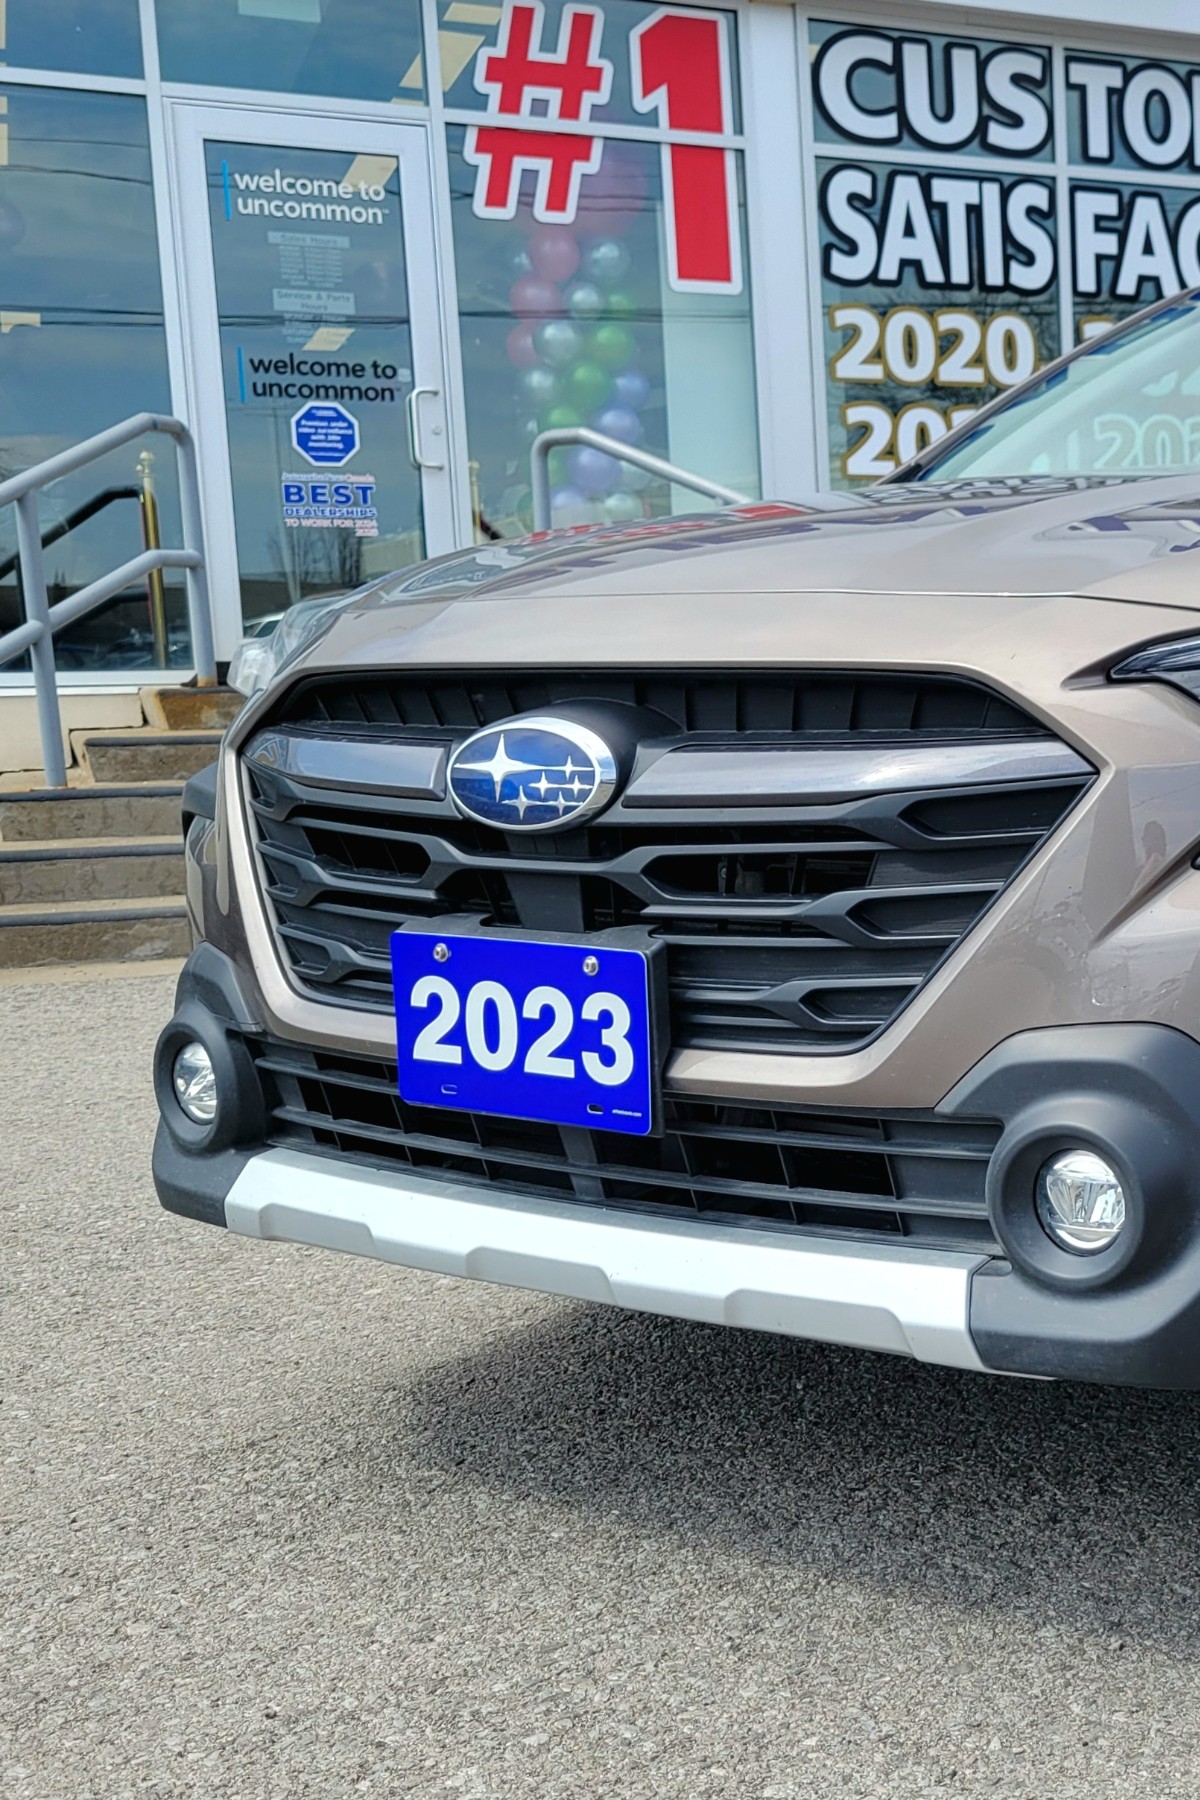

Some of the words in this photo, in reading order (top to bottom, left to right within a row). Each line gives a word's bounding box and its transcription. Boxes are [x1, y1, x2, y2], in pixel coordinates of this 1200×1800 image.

[466, 1, 740, 292] #1
[234, 168, 353, 199] welcome
[359, 180, 385, 202] to
[249, 352, 365, 378] welcome
[371, 360, 397, 379] to
[282, 483, 376, 506] BEST
[284, 506, 378, 518] DEALERSHIPS
[284, 518, 300, 528] TO
[300, 518, 333, 528] WORK
[333, 519, 354, 529] FOR
[410, 975, 634, 1086] 2023
